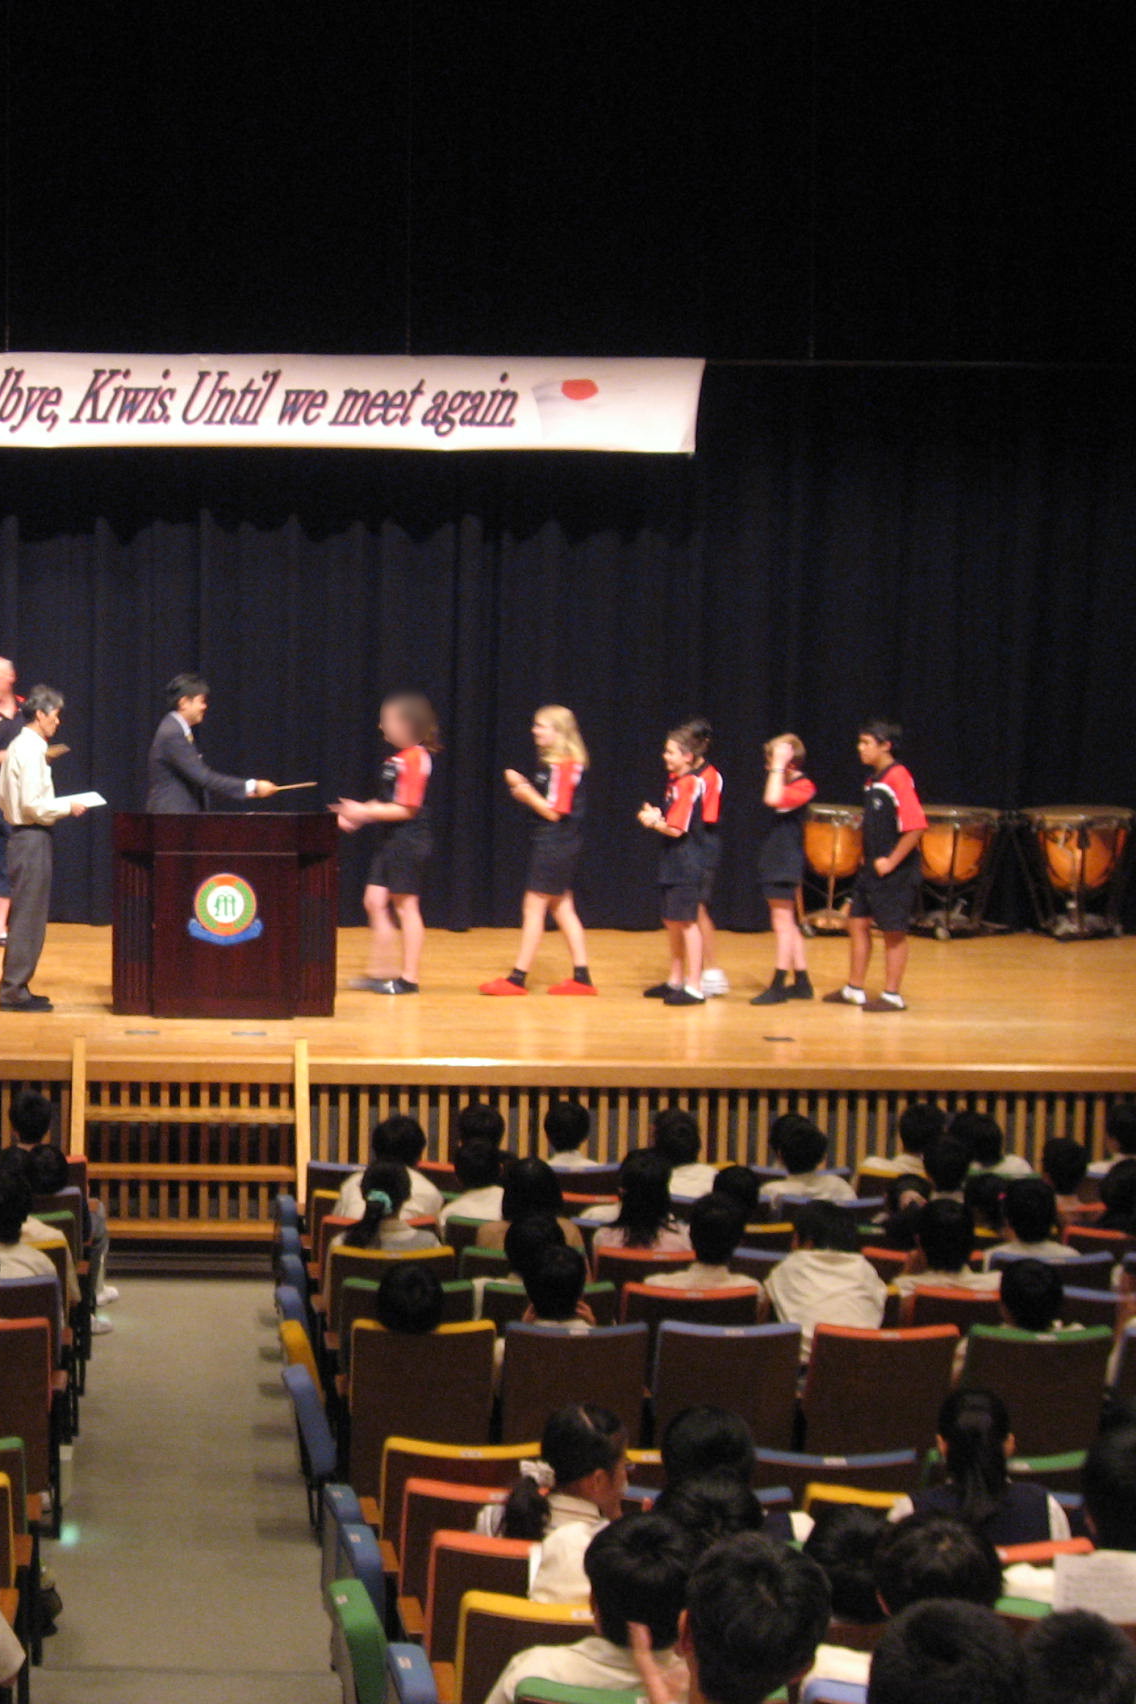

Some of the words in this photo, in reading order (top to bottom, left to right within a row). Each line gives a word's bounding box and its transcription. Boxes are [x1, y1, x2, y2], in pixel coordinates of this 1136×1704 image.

[181, 369, 282, 425] Until
[277, 388, 329, 426] we
[328, 378, 426, 427] meet
